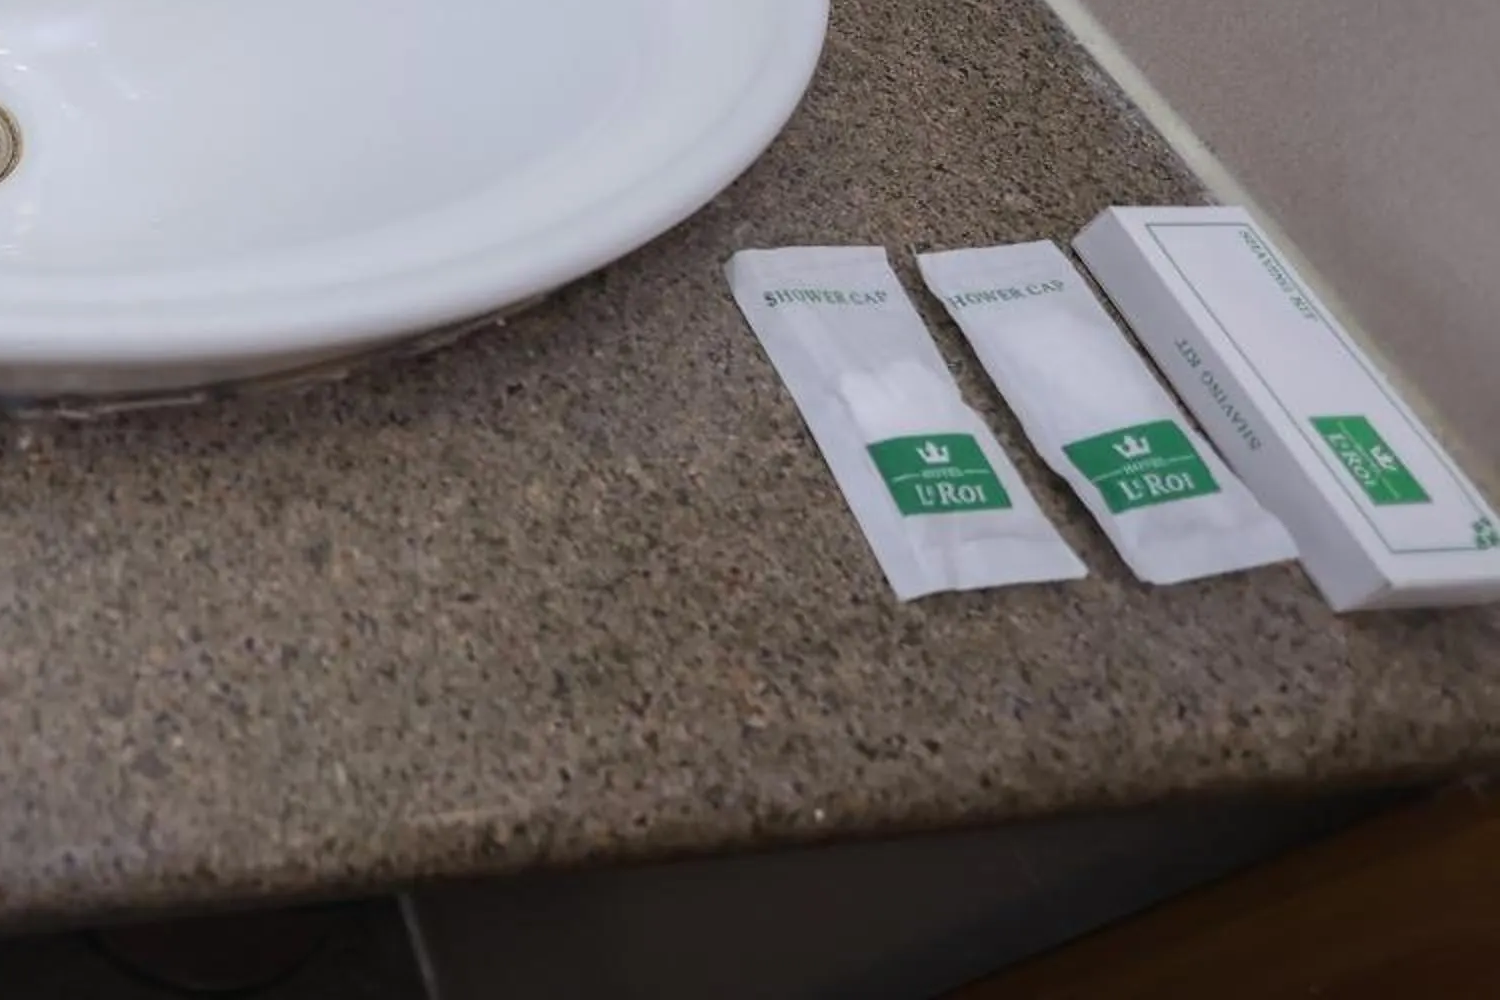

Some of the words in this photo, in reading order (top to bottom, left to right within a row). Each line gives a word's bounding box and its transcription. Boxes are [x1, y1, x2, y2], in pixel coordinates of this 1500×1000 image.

[762, 287, 848, 308] SHOWER
[849, 290, 888, 306] CAP
[947, 286, 1027, 309] HOWER
[1026, 279, 1065, 295] CAP
[1173, 336, 1201, 368] KIT
